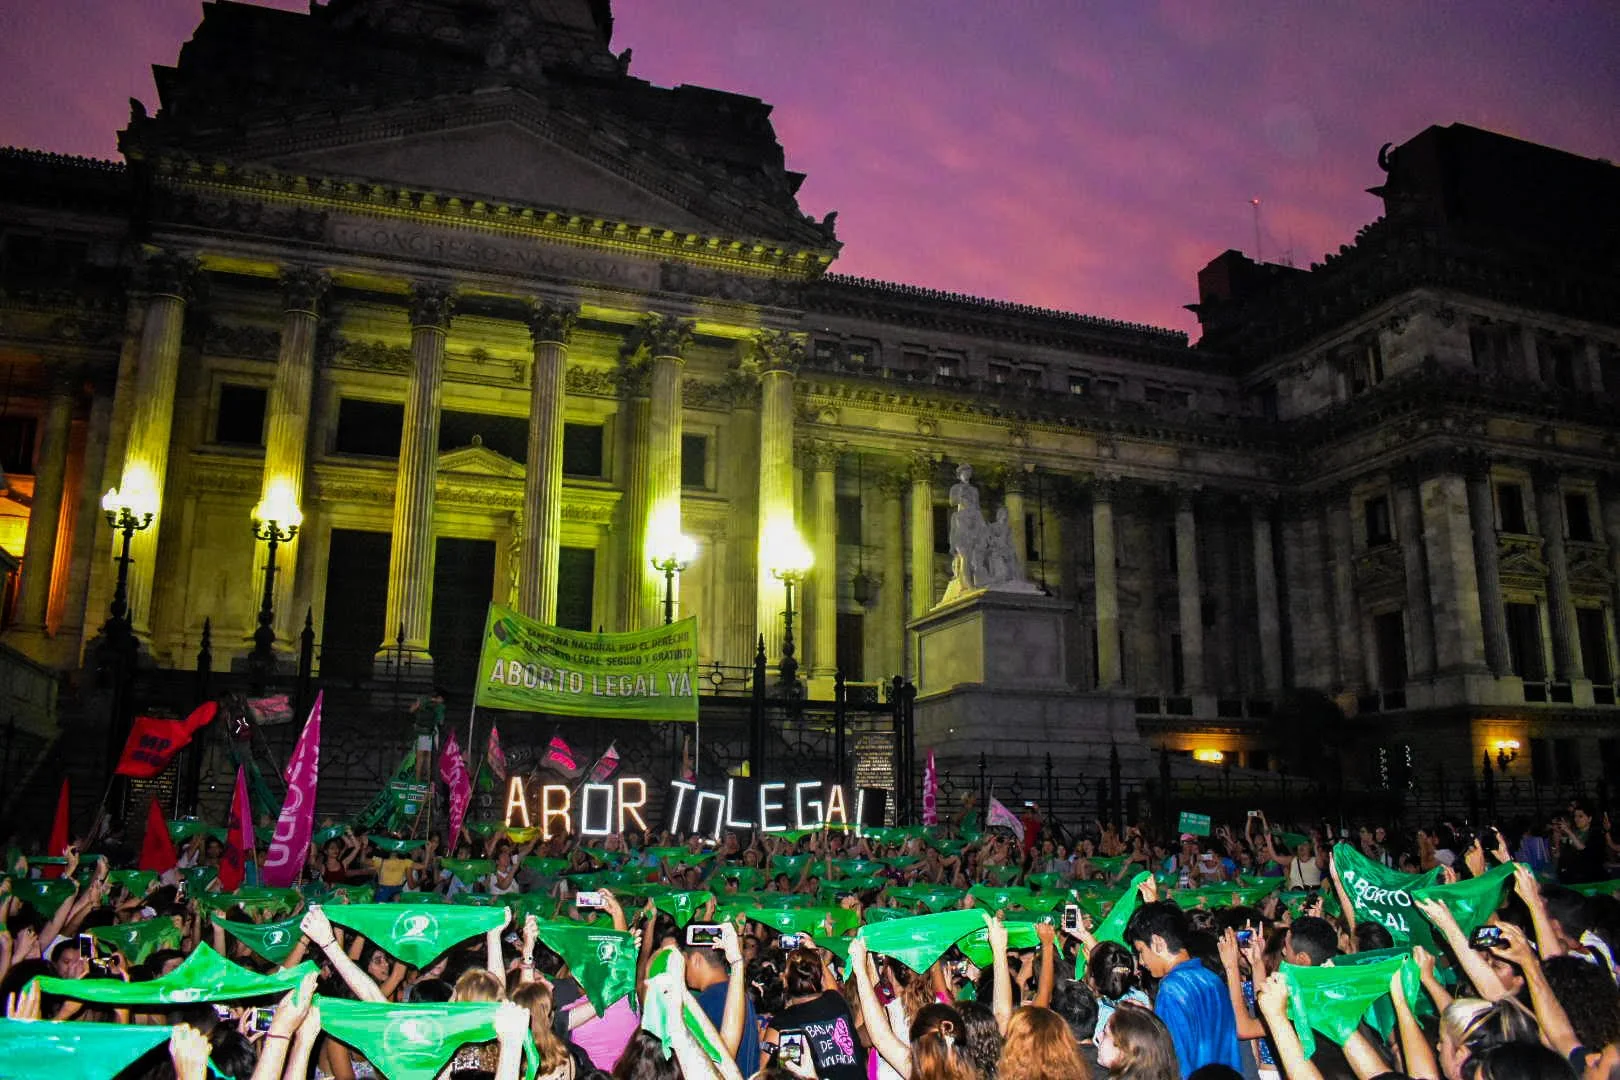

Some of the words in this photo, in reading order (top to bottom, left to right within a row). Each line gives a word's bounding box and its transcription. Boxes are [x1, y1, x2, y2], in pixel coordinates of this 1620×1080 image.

[355, 228, 498, 263] CONGRESO
[516, 248, 639, 287] NACIONAL
[571, 638, 617, 653] NACIONAL
[606, 655, 642, 666] SEGURO
[490, 658, 583, 695] ABORTO
[592, 673, 660, 697] LEGAL
[667, 672, 692, 697] YA
[1344, 870, 1412, 908] ABORTO
[820, 1039, 833, 1053] DE
